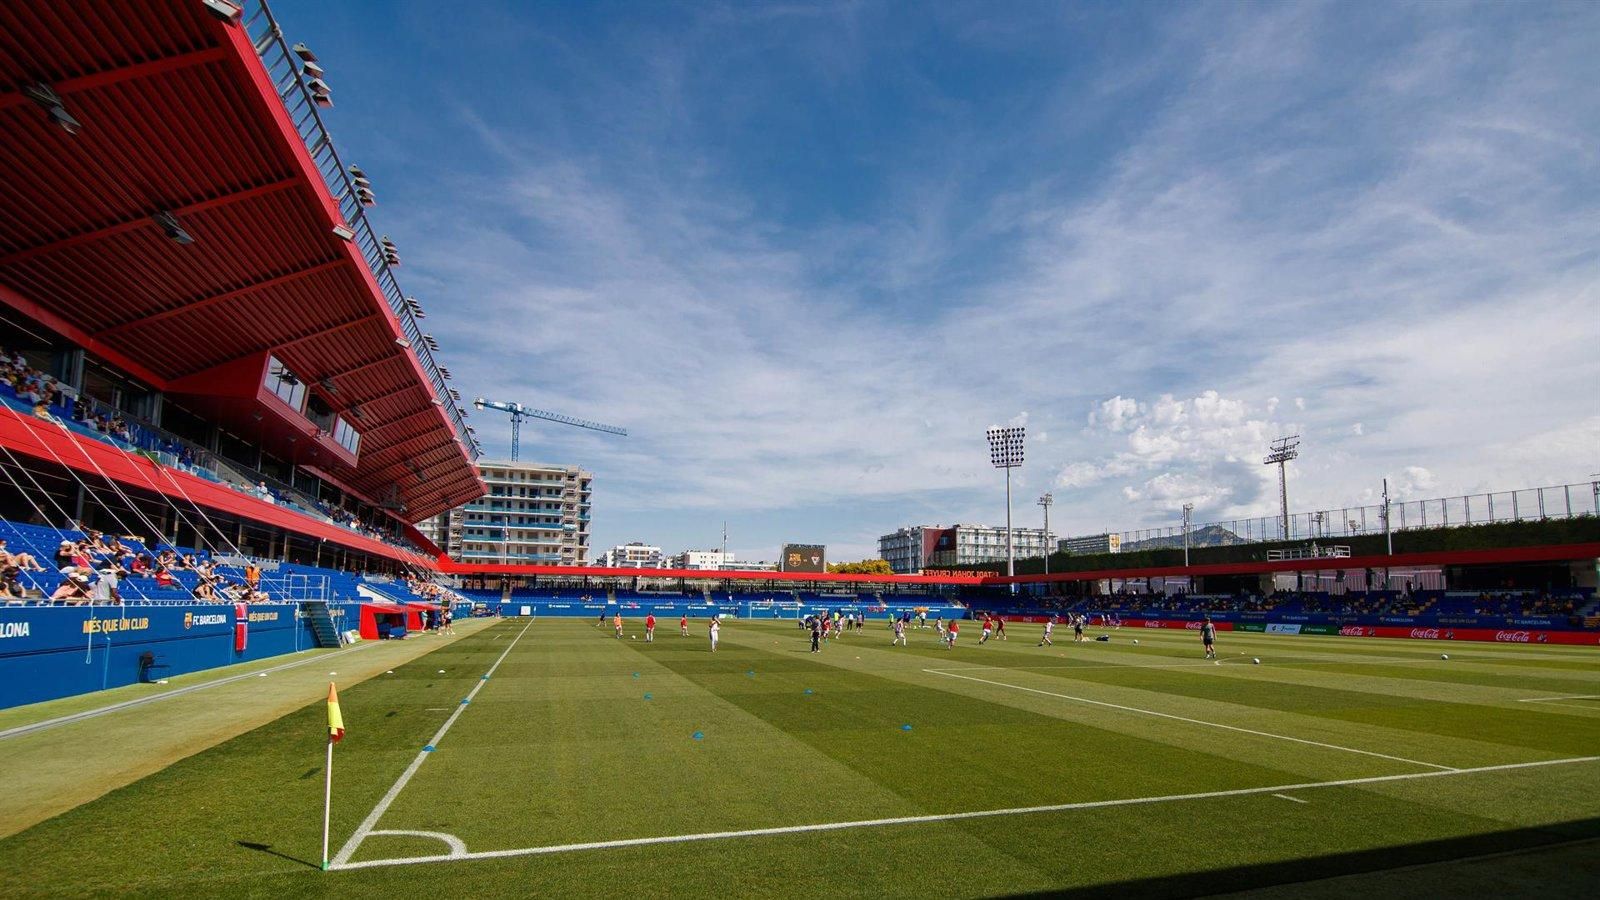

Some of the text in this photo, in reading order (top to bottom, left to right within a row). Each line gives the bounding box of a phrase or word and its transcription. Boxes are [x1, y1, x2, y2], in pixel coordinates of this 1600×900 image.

[82, 616, 149, 634] MÉS QUE UN CLUB
[192, 614, 227, 626] FC BARCELONA
